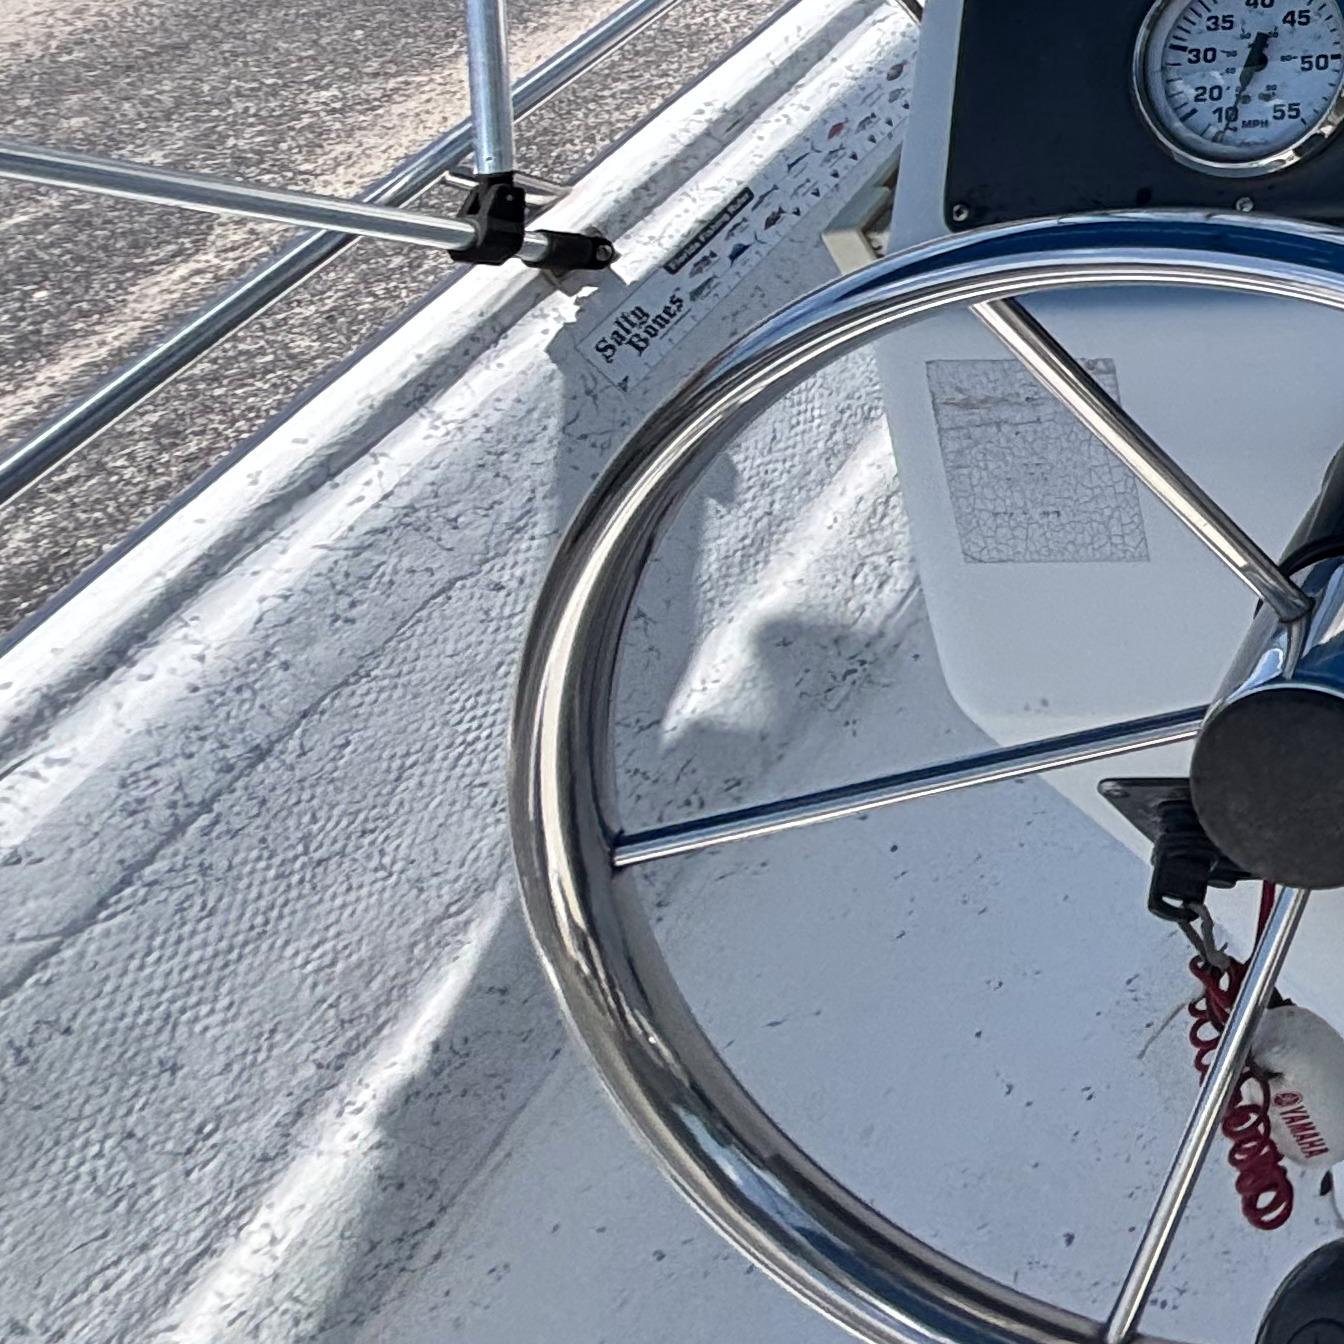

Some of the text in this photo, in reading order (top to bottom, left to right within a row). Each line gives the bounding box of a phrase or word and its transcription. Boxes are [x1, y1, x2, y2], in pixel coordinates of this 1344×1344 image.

[1206, 14, 1234, 31] 35
[1282, 10, 1311, 26] 45
[1187, 48, 1217, 63] 30
[1300, 55, 1329, 71] 50
[1194, 86, 1222, 102] 20
[1213, 107, 1239, 123] 10
[1272, 103, 1300, 120] 55
[1242, 120, 1269, 129] MPH
[624, 294, 684, 357] Bones
[1280, 1105, 1329, 1158] YAMAHA
